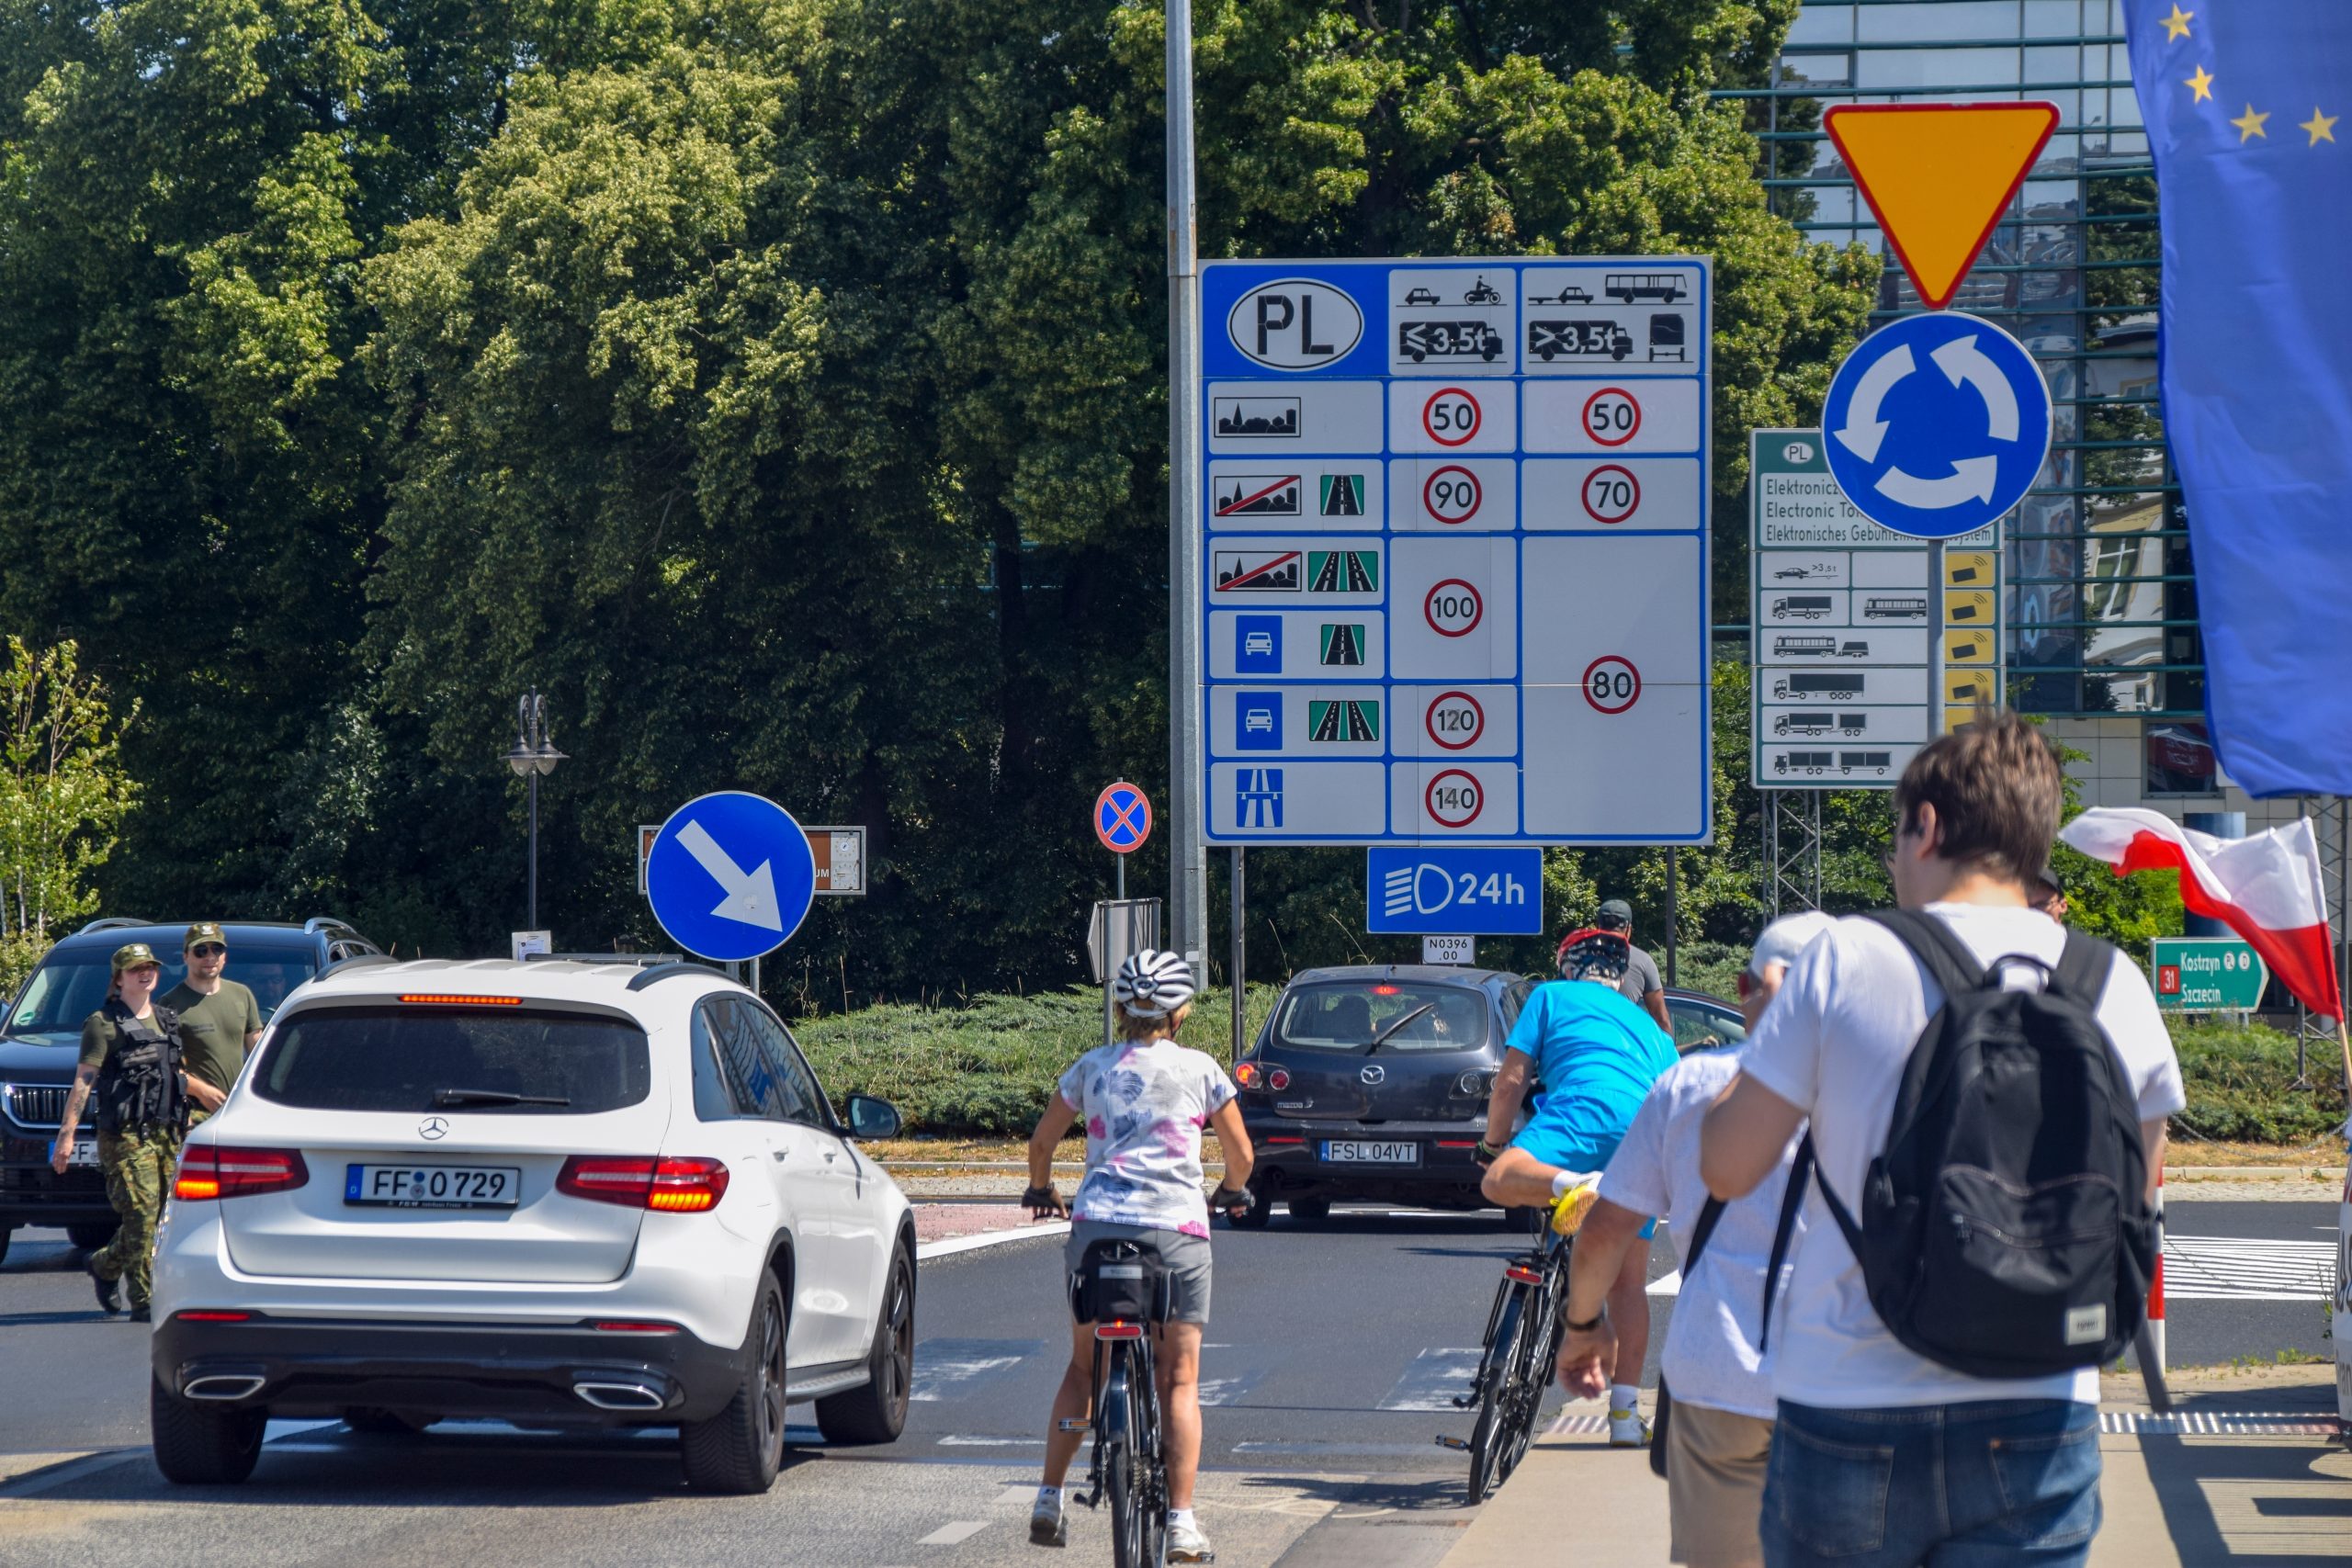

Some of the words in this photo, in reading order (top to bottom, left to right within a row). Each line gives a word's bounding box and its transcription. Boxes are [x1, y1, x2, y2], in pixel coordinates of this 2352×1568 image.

[1258, 295, 1334, 355] PL
[1433, 403, 1473, 430] 50
[1593, 403, 1633, 430] 50
[1790, 446, 1807, 460] PL
[1435, 481, 1472, 508] 90
[1596, 481, 1630, 508] 70
[1767, 479, 1842, 495] Elektronicz
[1767, 502, 1835, 518] Electronic
[1767, 525, 1847, 541] Elektronisches
[1434, 597, 1474, 618] 100
[1593, 671, 1632, 698] 80
[1438, 710, 1474, 731] 120
[1436, 788, 1475, 809] 140
[1459, 874, 1523, 905] 24h
[1430, 939, 1467, 949] N0396
[2180, 953, 2221, 976] Kostrzyn
[2165, 970, 2175, 990] 31
[2181, 983, 2222, 1003] Szczecin
[1332, 1143, 1366, 1160] FSL
[1373, 1144, 1413, 1160] 04VT
[373, 1170, 412, 1197] FF
[455, 1172, 505, 1199] 729
